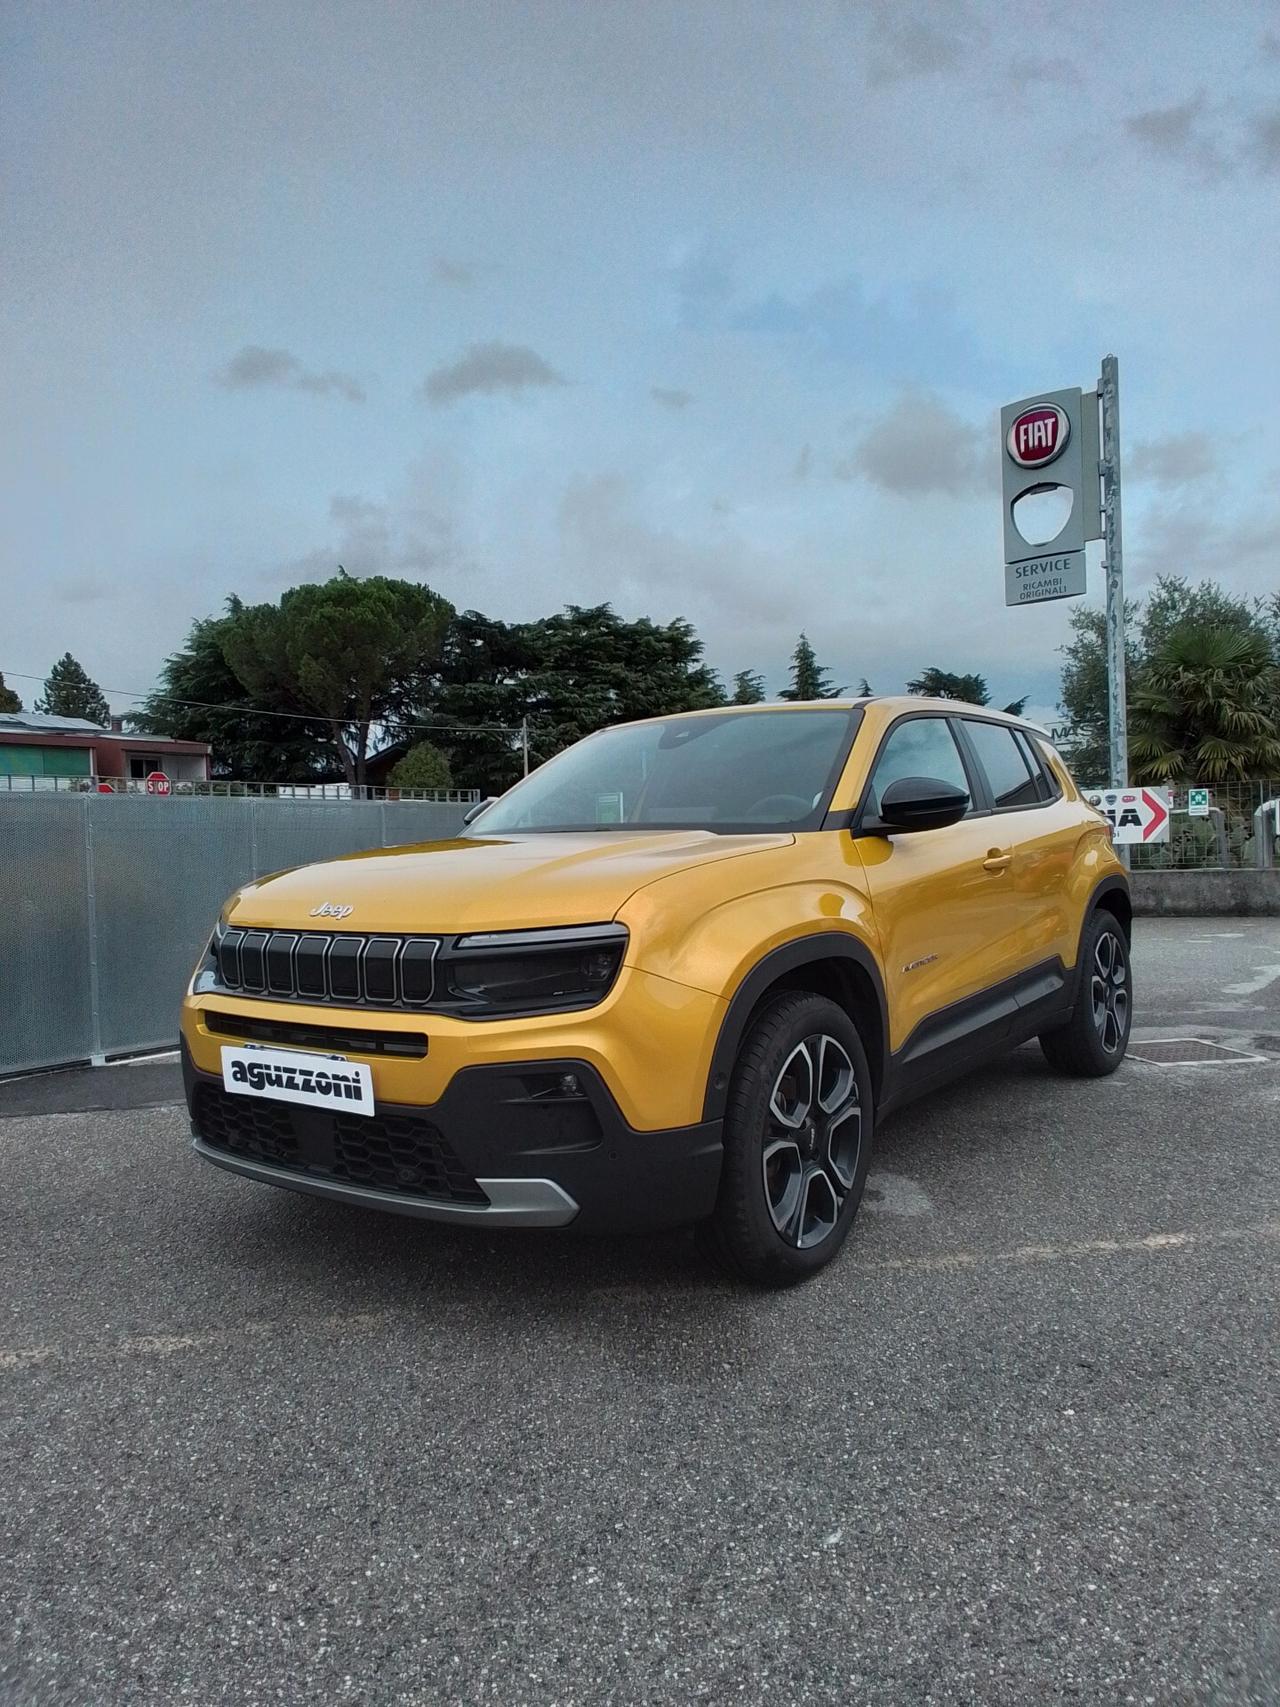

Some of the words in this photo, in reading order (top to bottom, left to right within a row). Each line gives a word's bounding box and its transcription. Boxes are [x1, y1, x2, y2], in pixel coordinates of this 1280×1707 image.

[1020, 417, 1056, 454] FIAT
[1015, 558, 1071, 579] SERVICE
[1020, 586, 1067, 600] ORIGINALI
[1023, 578, 1063, 592] RICAMBI
[148, 781, 169, 792] SOP
[309, 902, 354, 920] Jeep
[231, 1060, 363, 1101] aguzzoni
